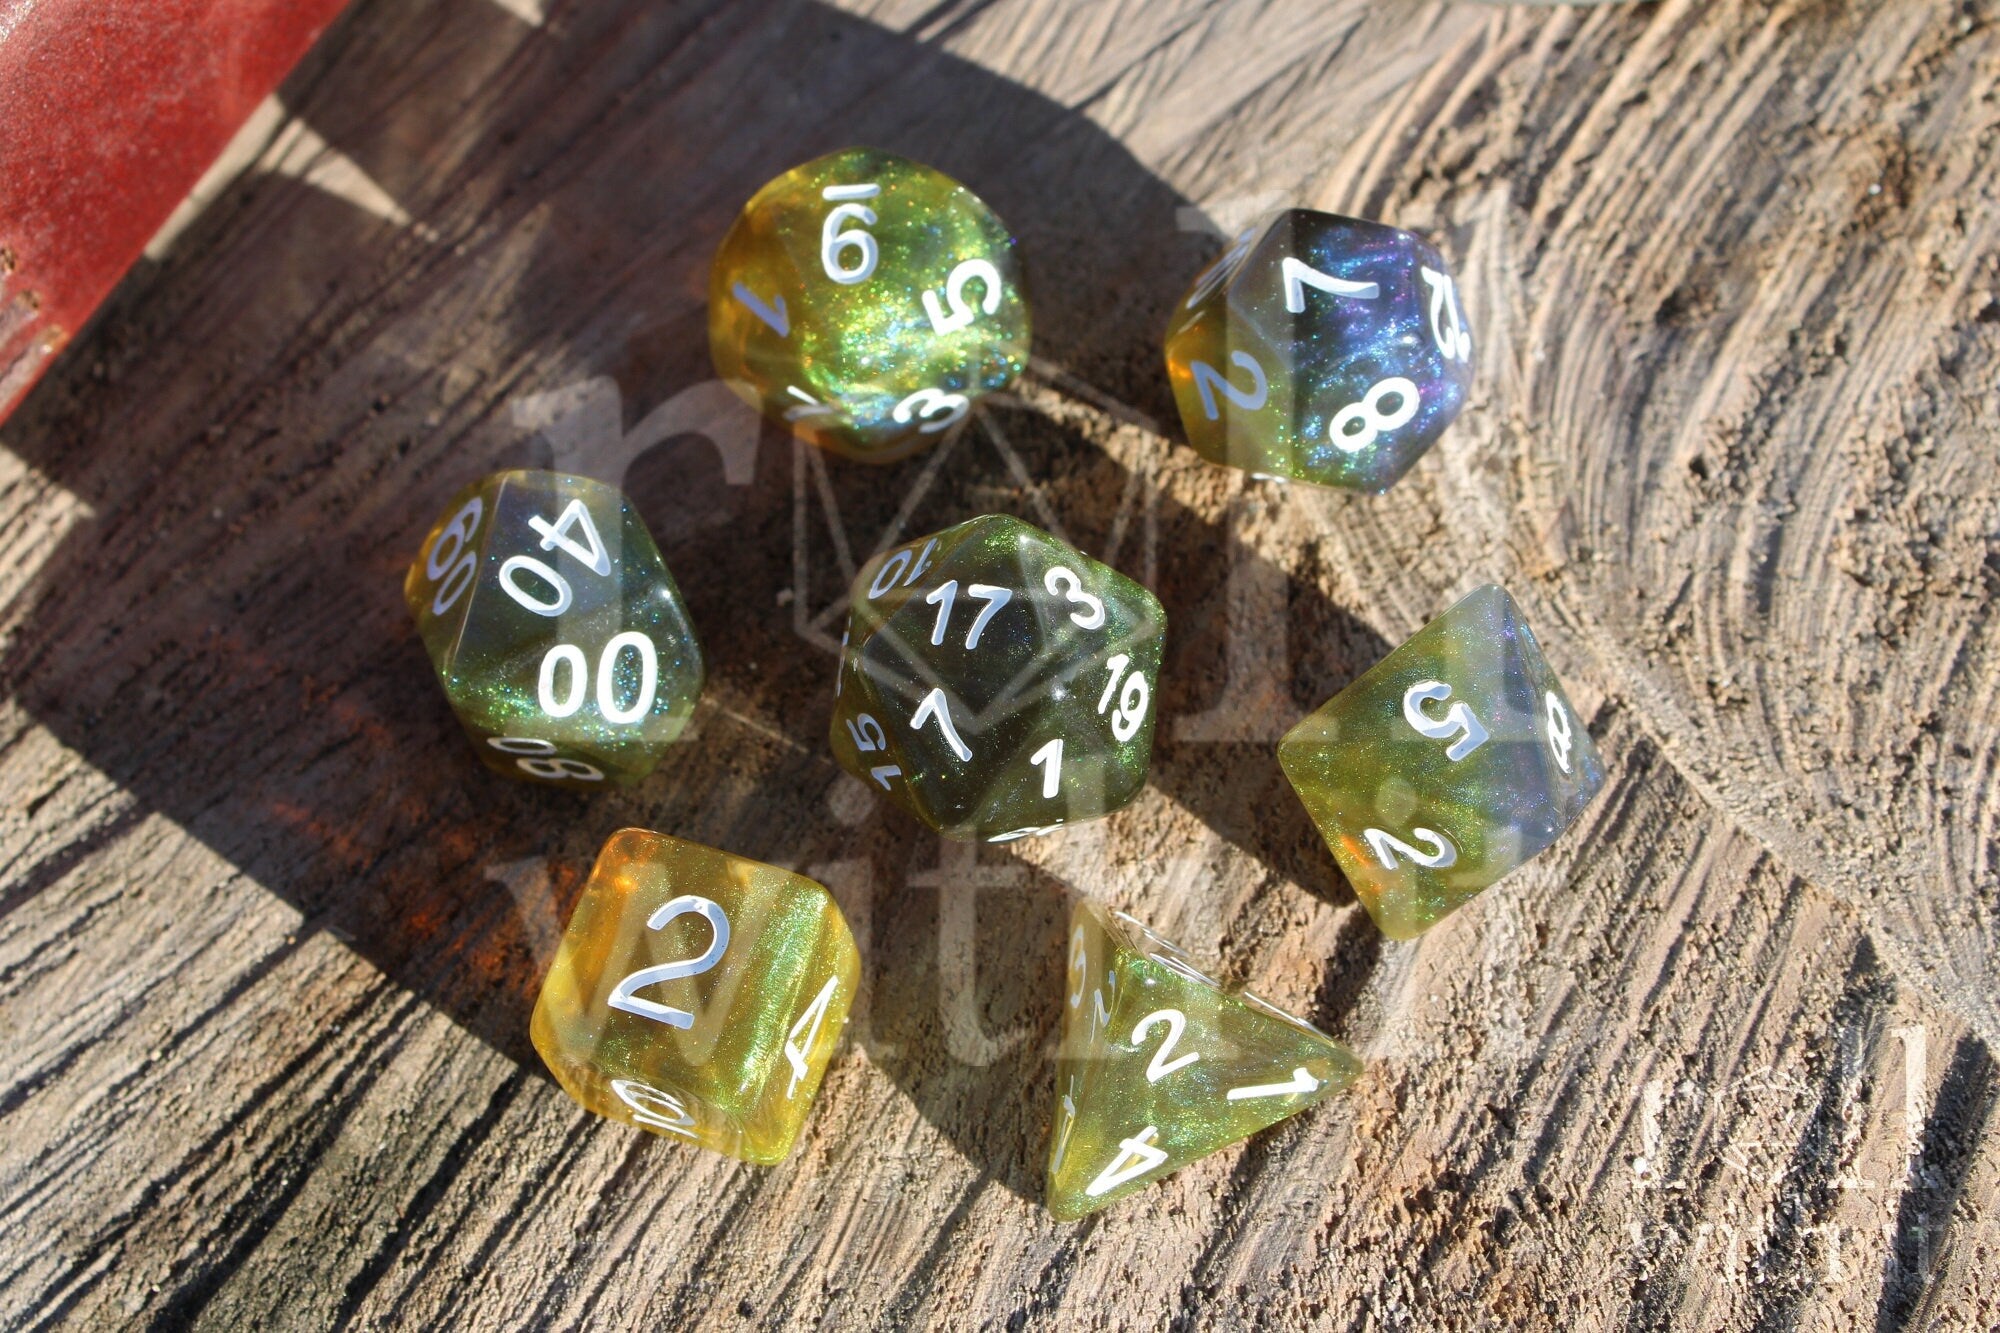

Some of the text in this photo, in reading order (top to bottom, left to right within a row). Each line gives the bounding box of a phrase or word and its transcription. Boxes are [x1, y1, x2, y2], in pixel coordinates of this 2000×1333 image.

[922, 258, 1001, 336] 5
[1282, 256, 1380, 313] 7
[893, 387, 969, 433] 3
[1190, 350, 1268, 421] 2
[1329, 376, 1421, 453] 8
[500, 499, 611, 617] 40
[869, 538, 938, 599] 10
[925, 580, 1012, 650] 17
[1044, 566, 1106, 630] 3
[538, 631, 658, 724] 00
[1098, 653, 1149, 742] 19
[846, 713, 902, 791] 15
[1403, 680, 1491, 762] 5
[1030, 738, 1064, 799] 1
[1363, 827, 1458, 871] 2
[607, 895, 730, 1030] 2
[784, 975, 838, 1099] 4
[1131, 1009, 1200, 1084] 2
[1226, 1067, 1319, 1100] 1
[1085, 1125, 1169, 1197] 4
